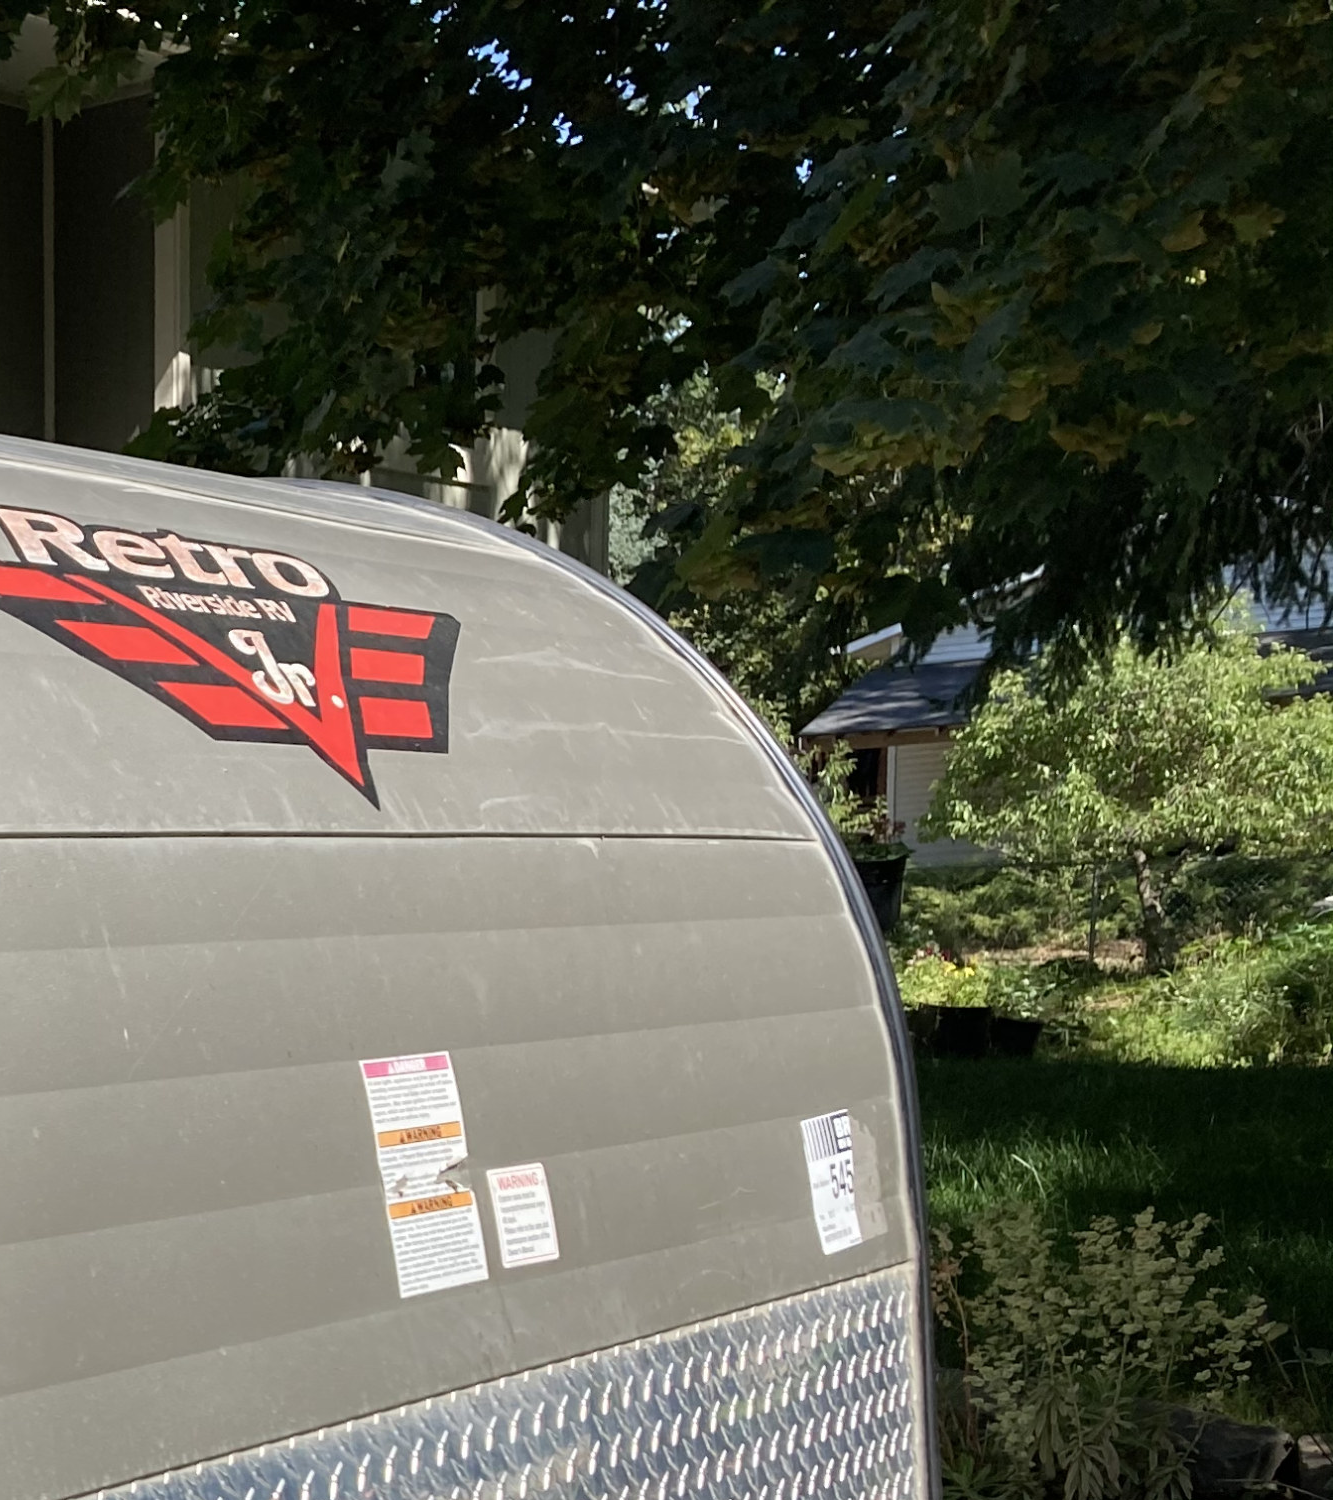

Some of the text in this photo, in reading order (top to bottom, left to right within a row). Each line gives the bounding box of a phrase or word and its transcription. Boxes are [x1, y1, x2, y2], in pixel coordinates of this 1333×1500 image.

[136, 585, 296, 623] Riverside RV
[405, 1125, 442, 1142] WARNING
[497, 1172, 540, 1191] WARNING
[416, 1194, 453, 1212] WARNING
